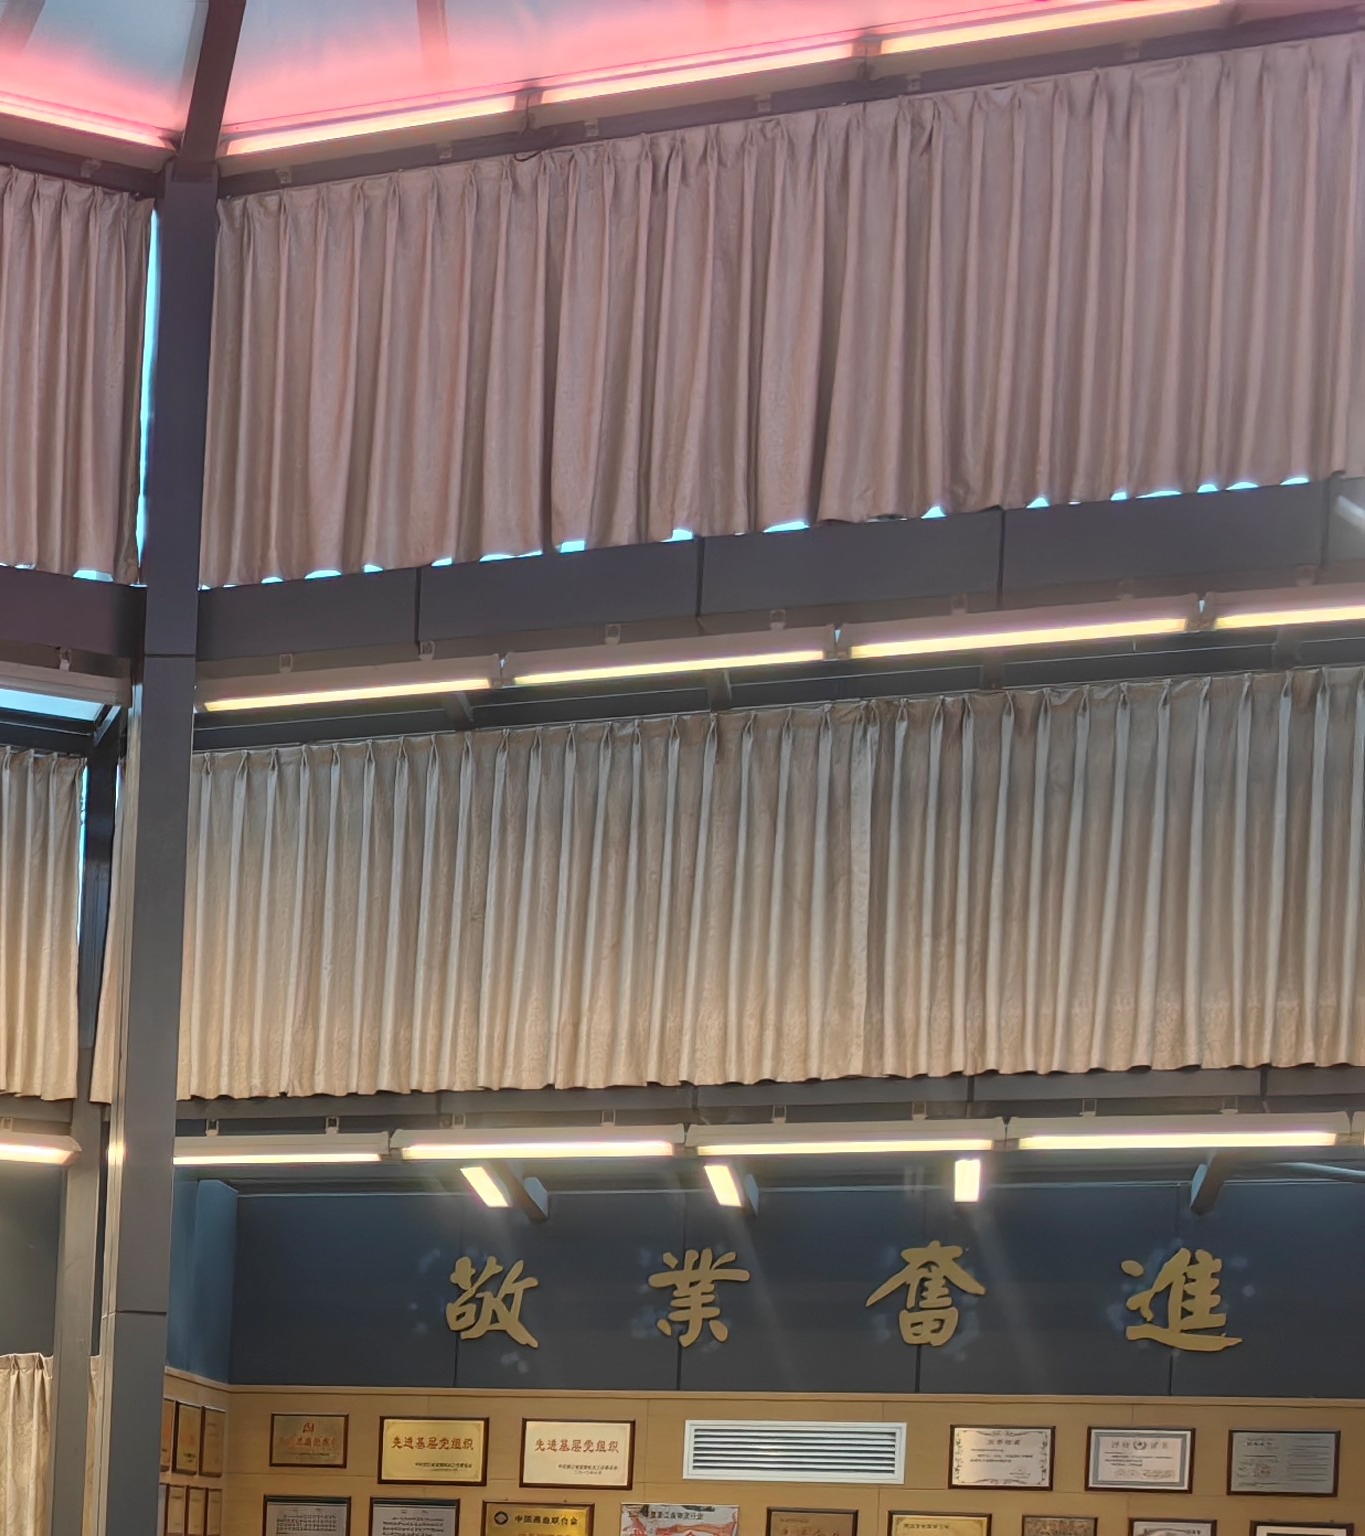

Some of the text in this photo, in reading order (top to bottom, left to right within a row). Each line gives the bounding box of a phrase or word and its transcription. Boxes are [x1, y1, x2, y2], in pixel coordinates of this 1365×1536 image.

[445, 1240, 1243, 1352] 敬業奮進
[391, 1435, 475, 1451] 先进基层党组织
[534, 1437, 620, 1454] 先进基层党组织
